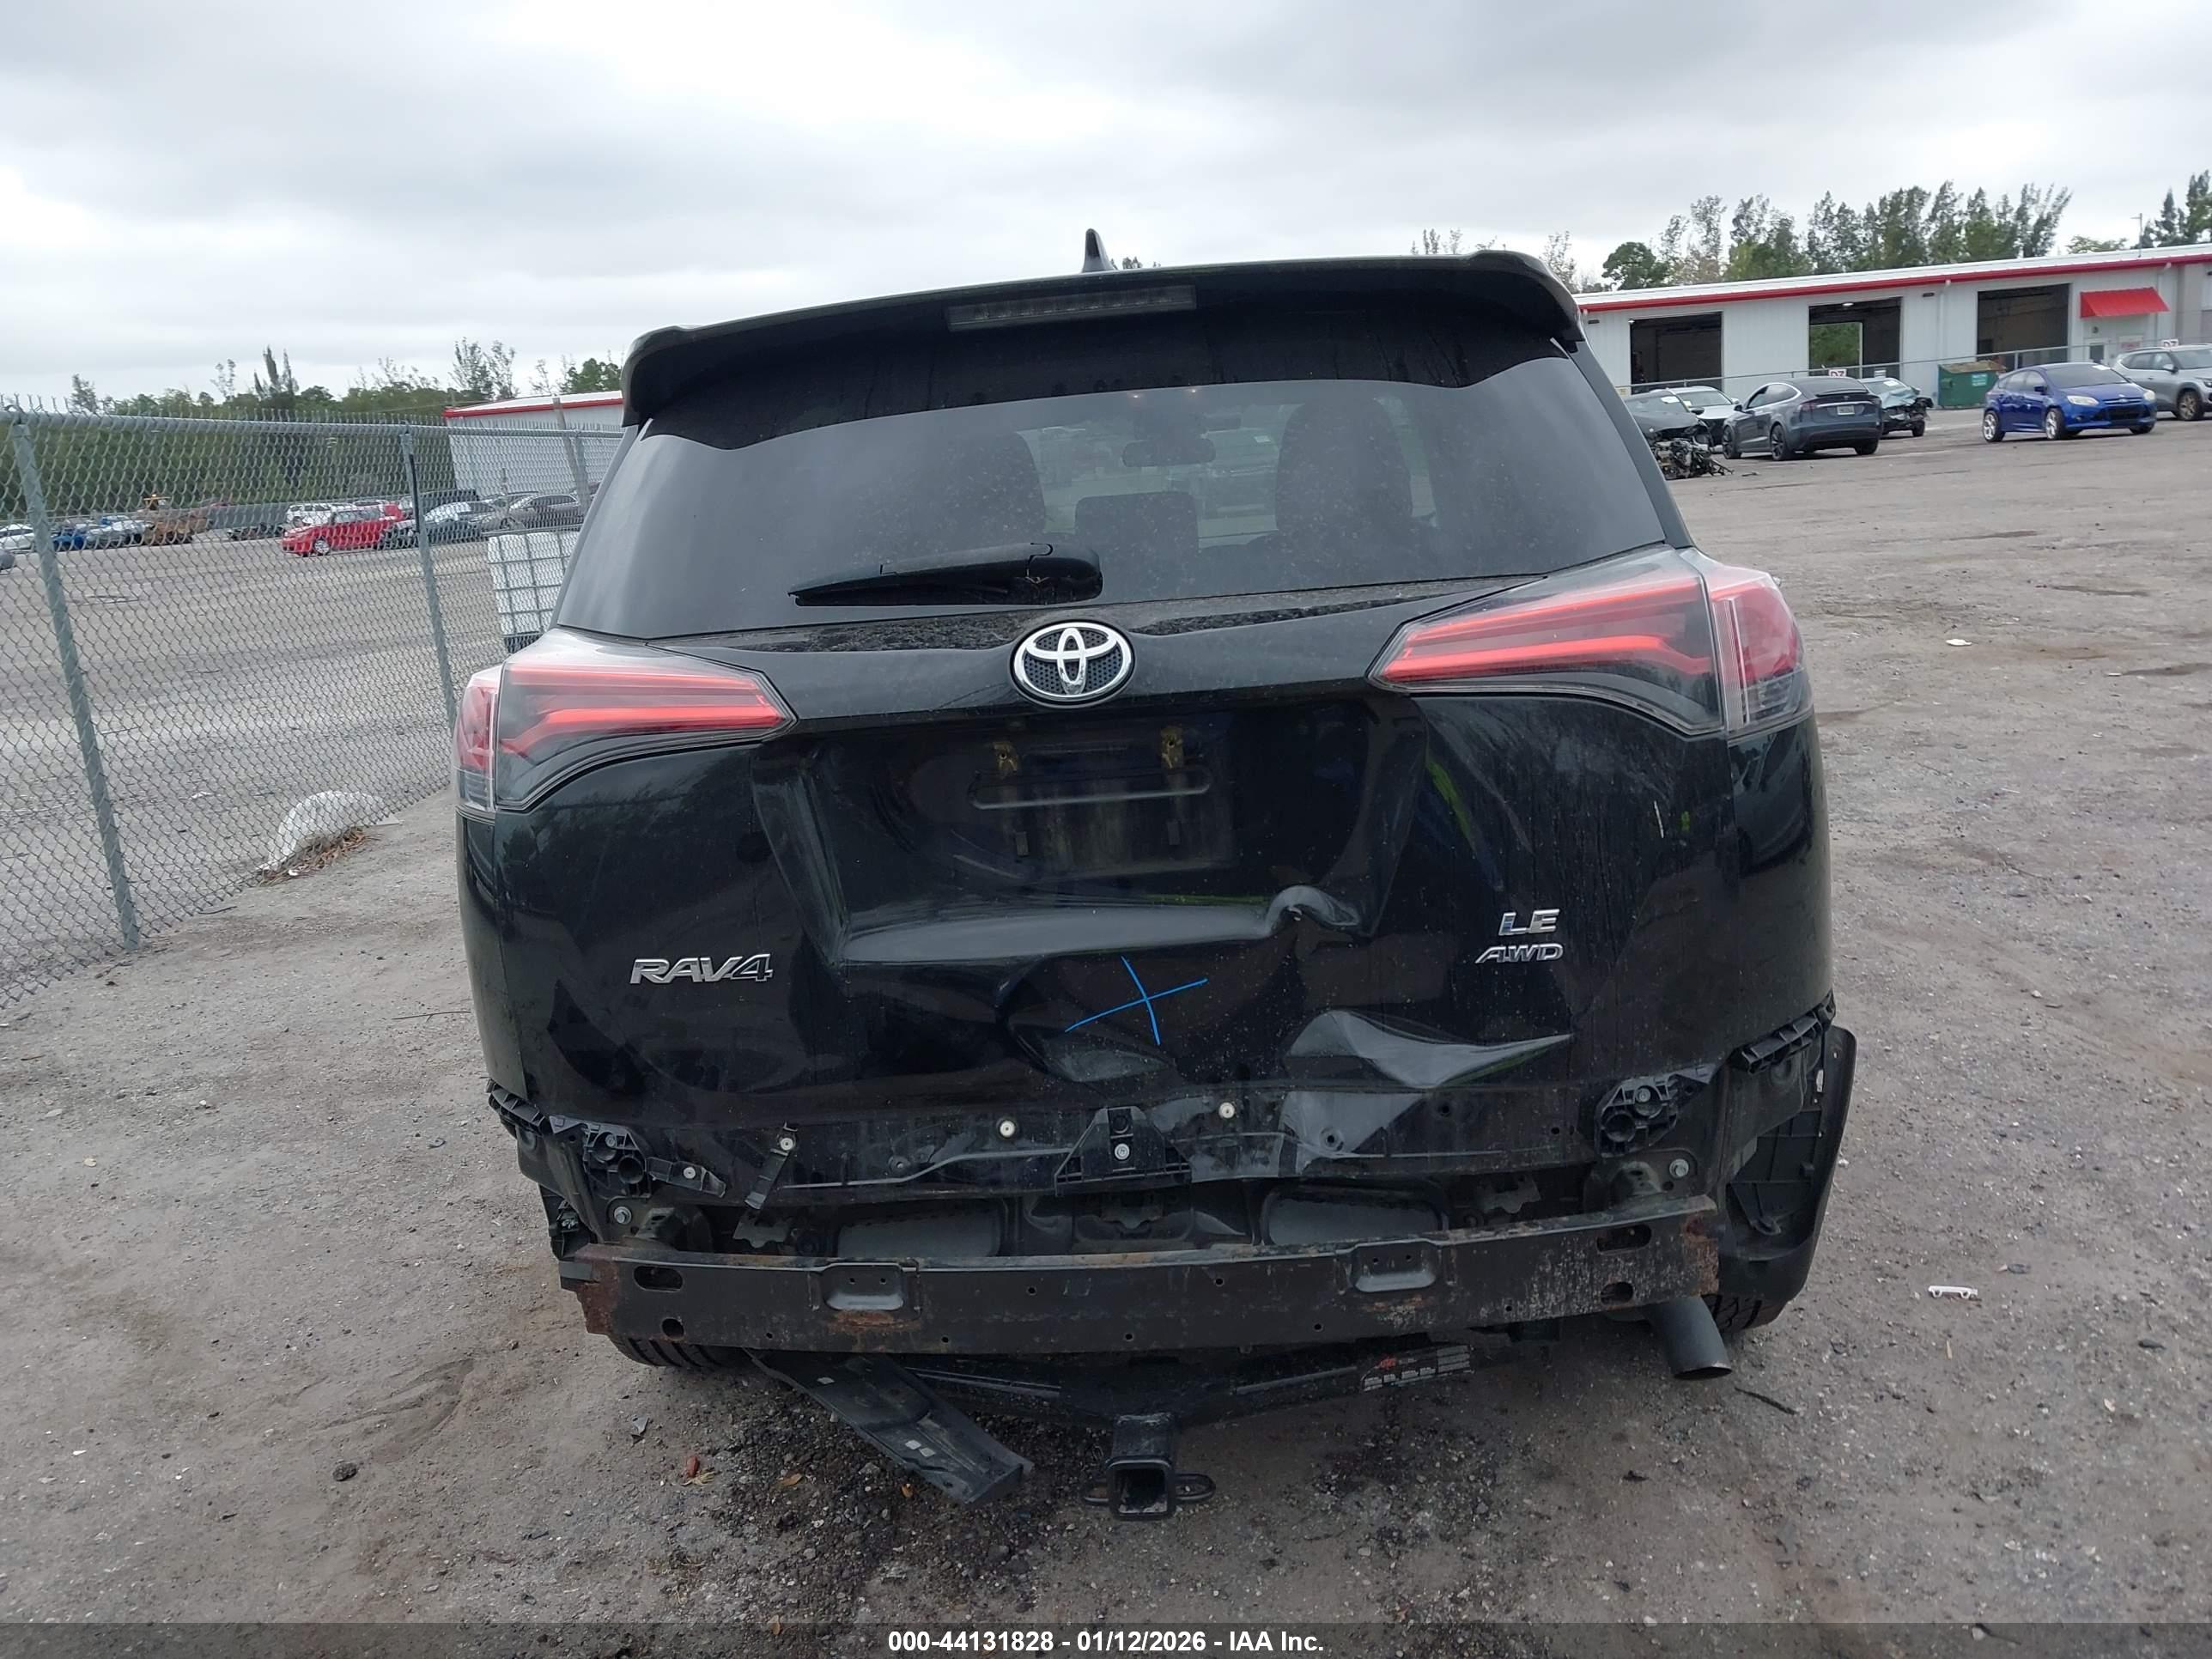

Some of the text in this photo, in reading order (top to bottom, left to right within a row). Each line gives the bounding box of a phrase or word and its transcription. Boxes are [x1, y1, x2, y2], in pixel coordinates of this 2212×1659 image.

[1498, 908, 1560, 936] LE
[1474, 943, 1564, 963] AWD
[629, 953, 774, 984] RAV4
